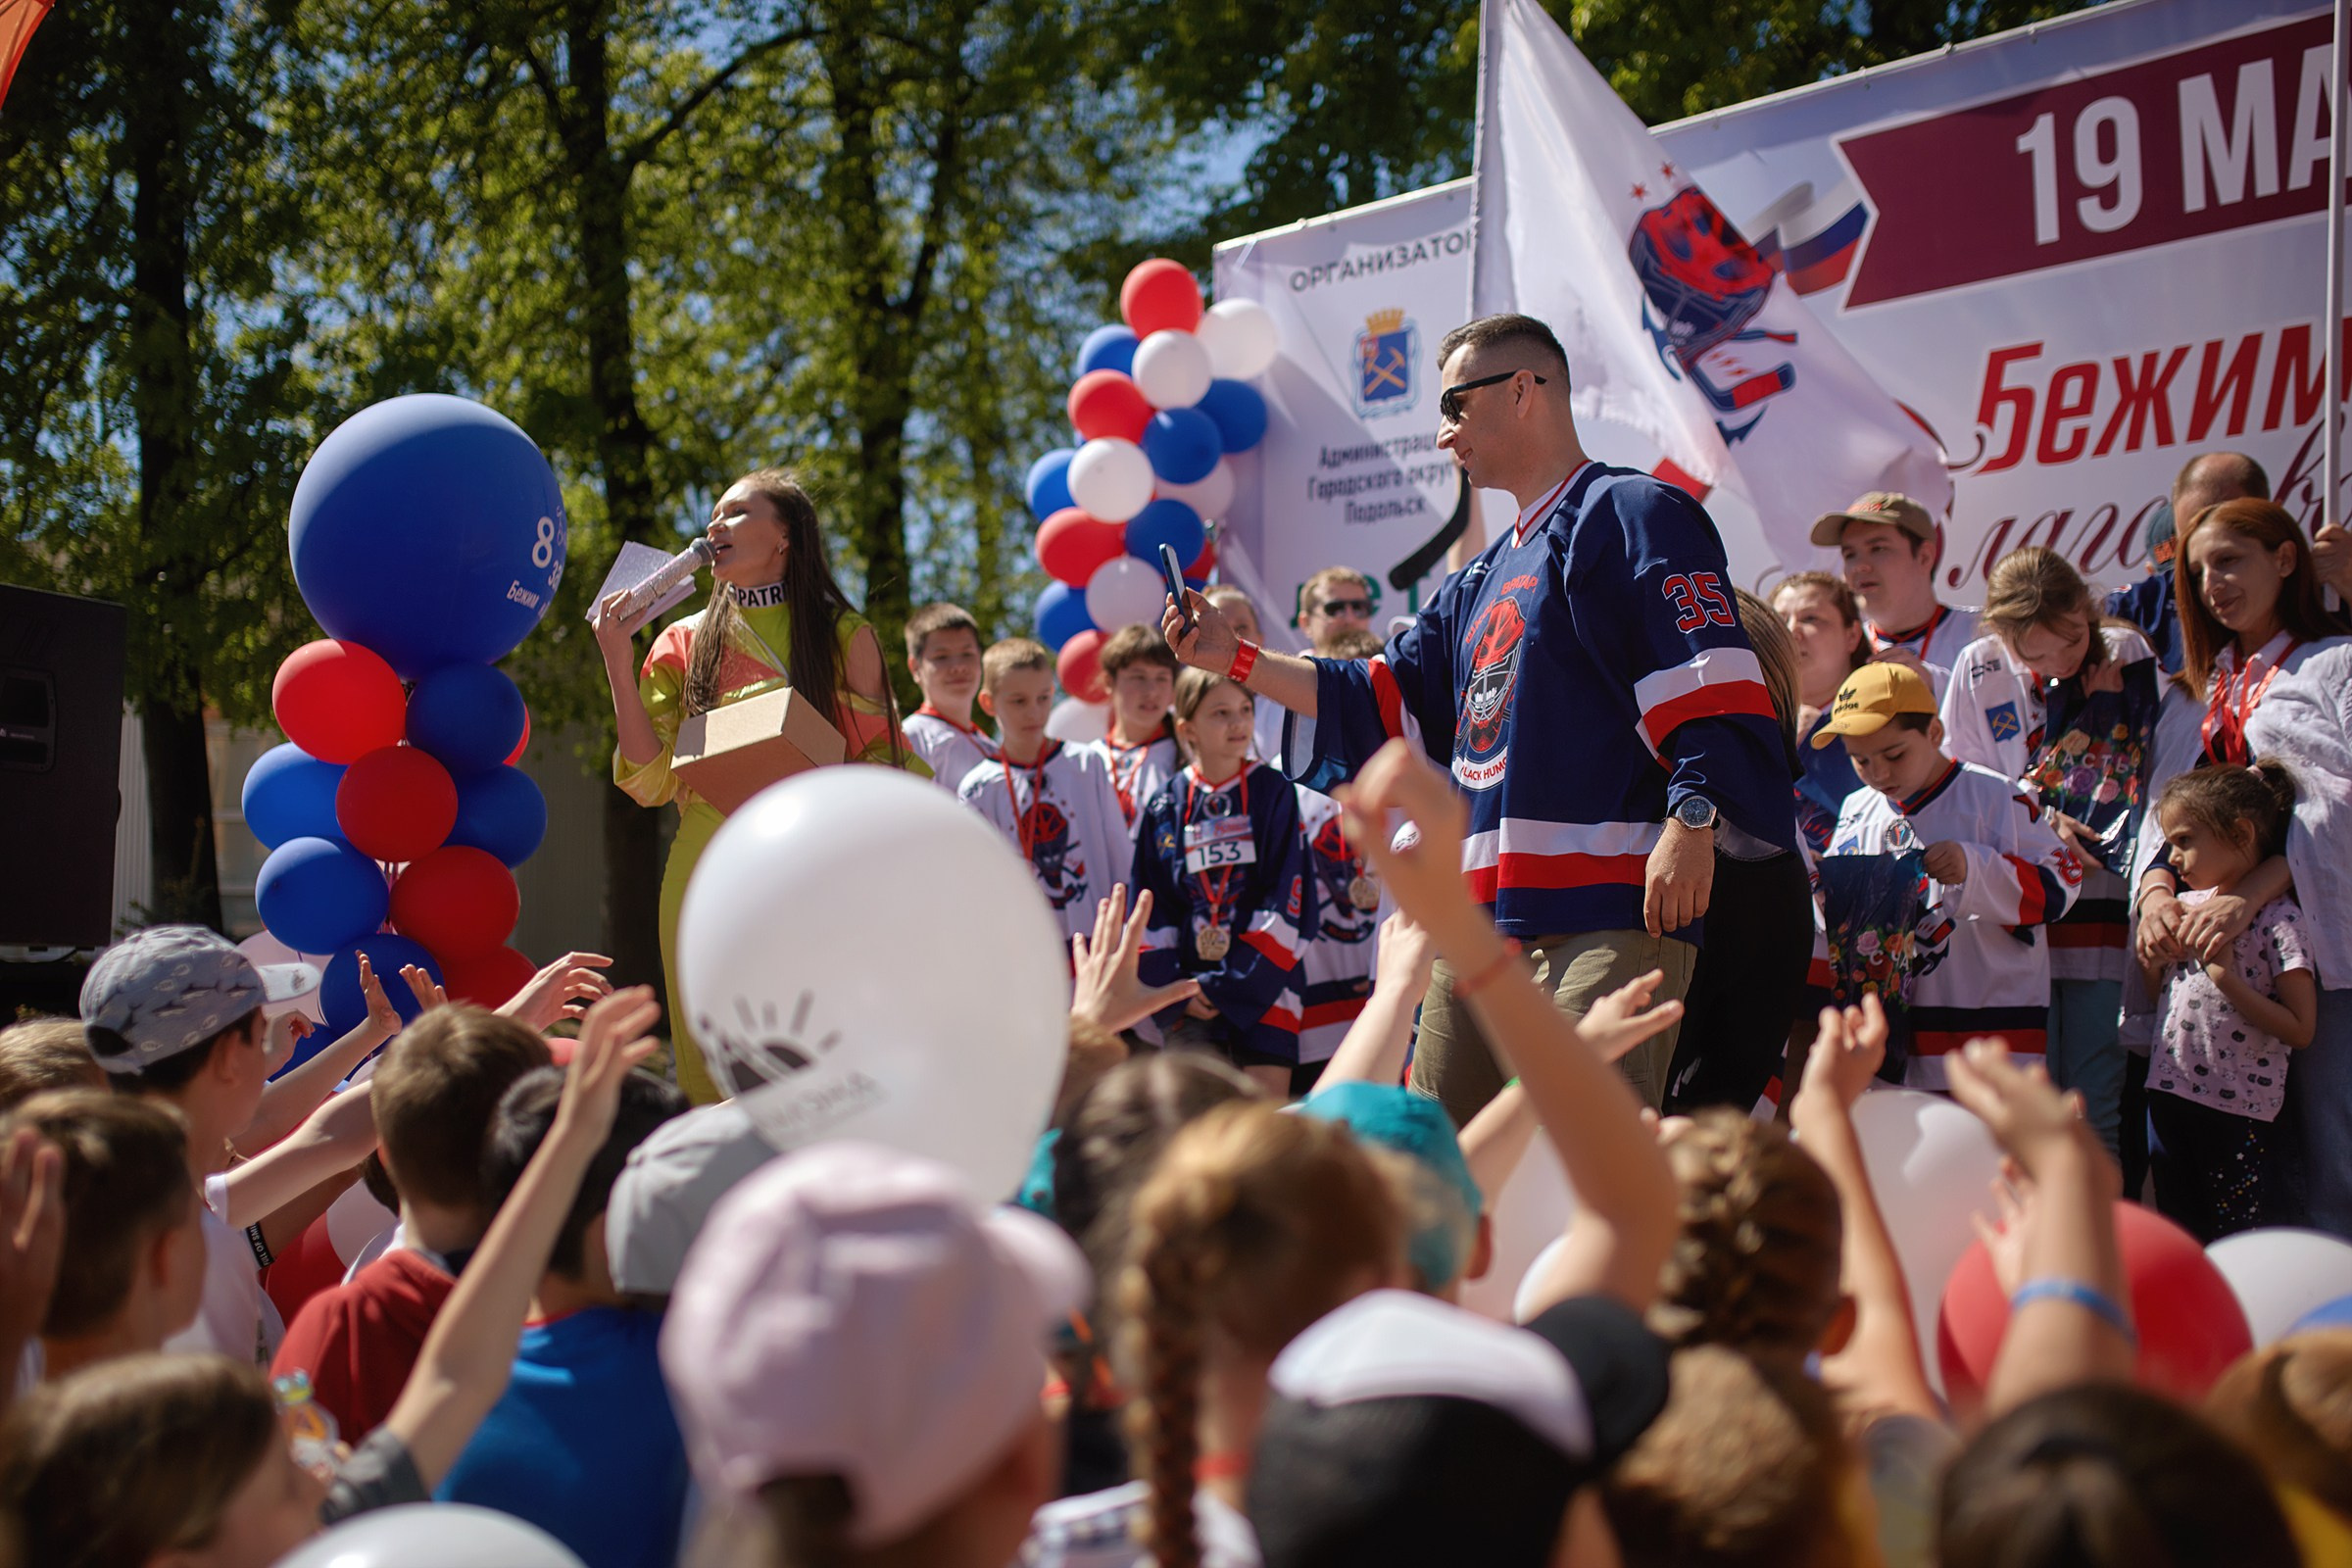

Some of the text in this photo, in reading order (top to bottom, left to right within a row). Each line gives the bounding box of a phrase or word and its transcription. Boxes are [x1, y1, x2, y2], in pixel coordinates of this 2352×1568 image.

[2016, 96, 2143, 246] 19
[1970, 315, 2352, 477] Бежим
[1344, 495, 1427, 525] Подольск
[532, 516, 555, 568] 8
[506, 579, 540, 610] Бежим
[735, 583, 784, 608] PATR
[1662, 571, 1736, 634] 35
[1197, 841, 1242, 867] 153
